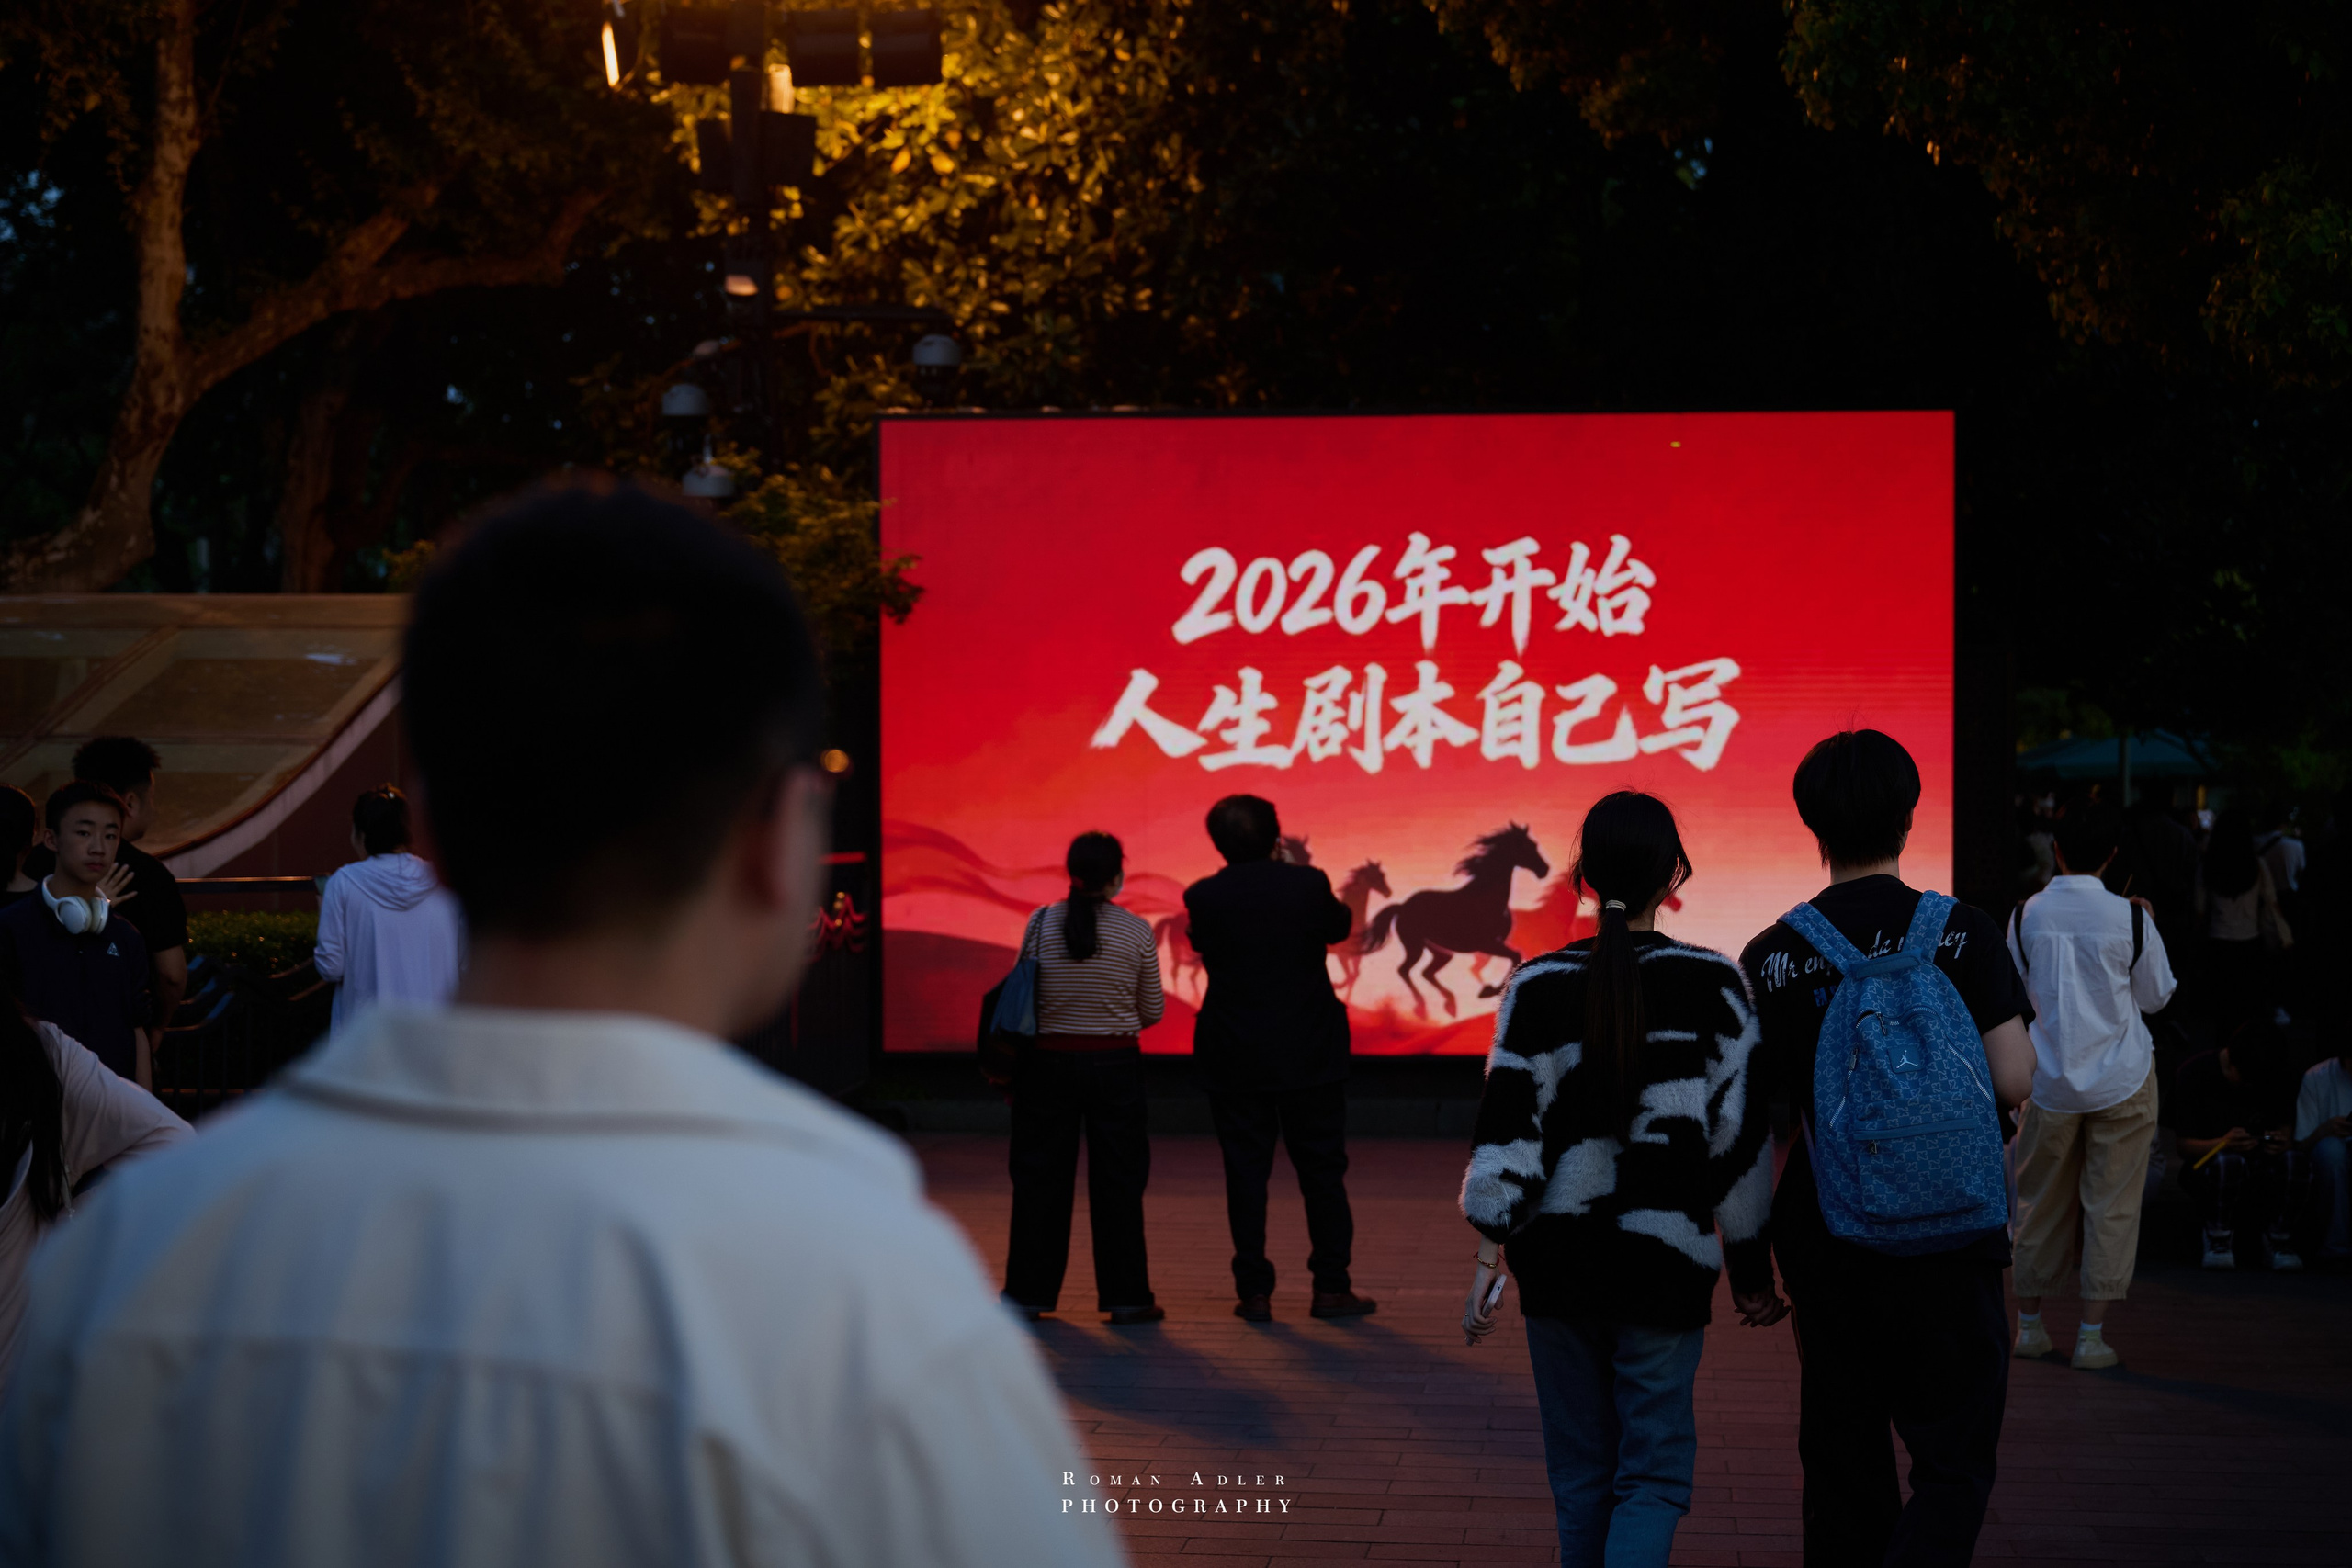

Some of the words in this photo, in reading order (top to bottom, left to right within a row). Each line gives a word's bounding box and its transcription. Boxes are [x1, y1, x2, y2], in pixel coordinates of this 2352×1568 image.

[1172, 531, 1657, 658] 2026年开始
[1090, 657, 1742, 774] 人生剧本自己写
